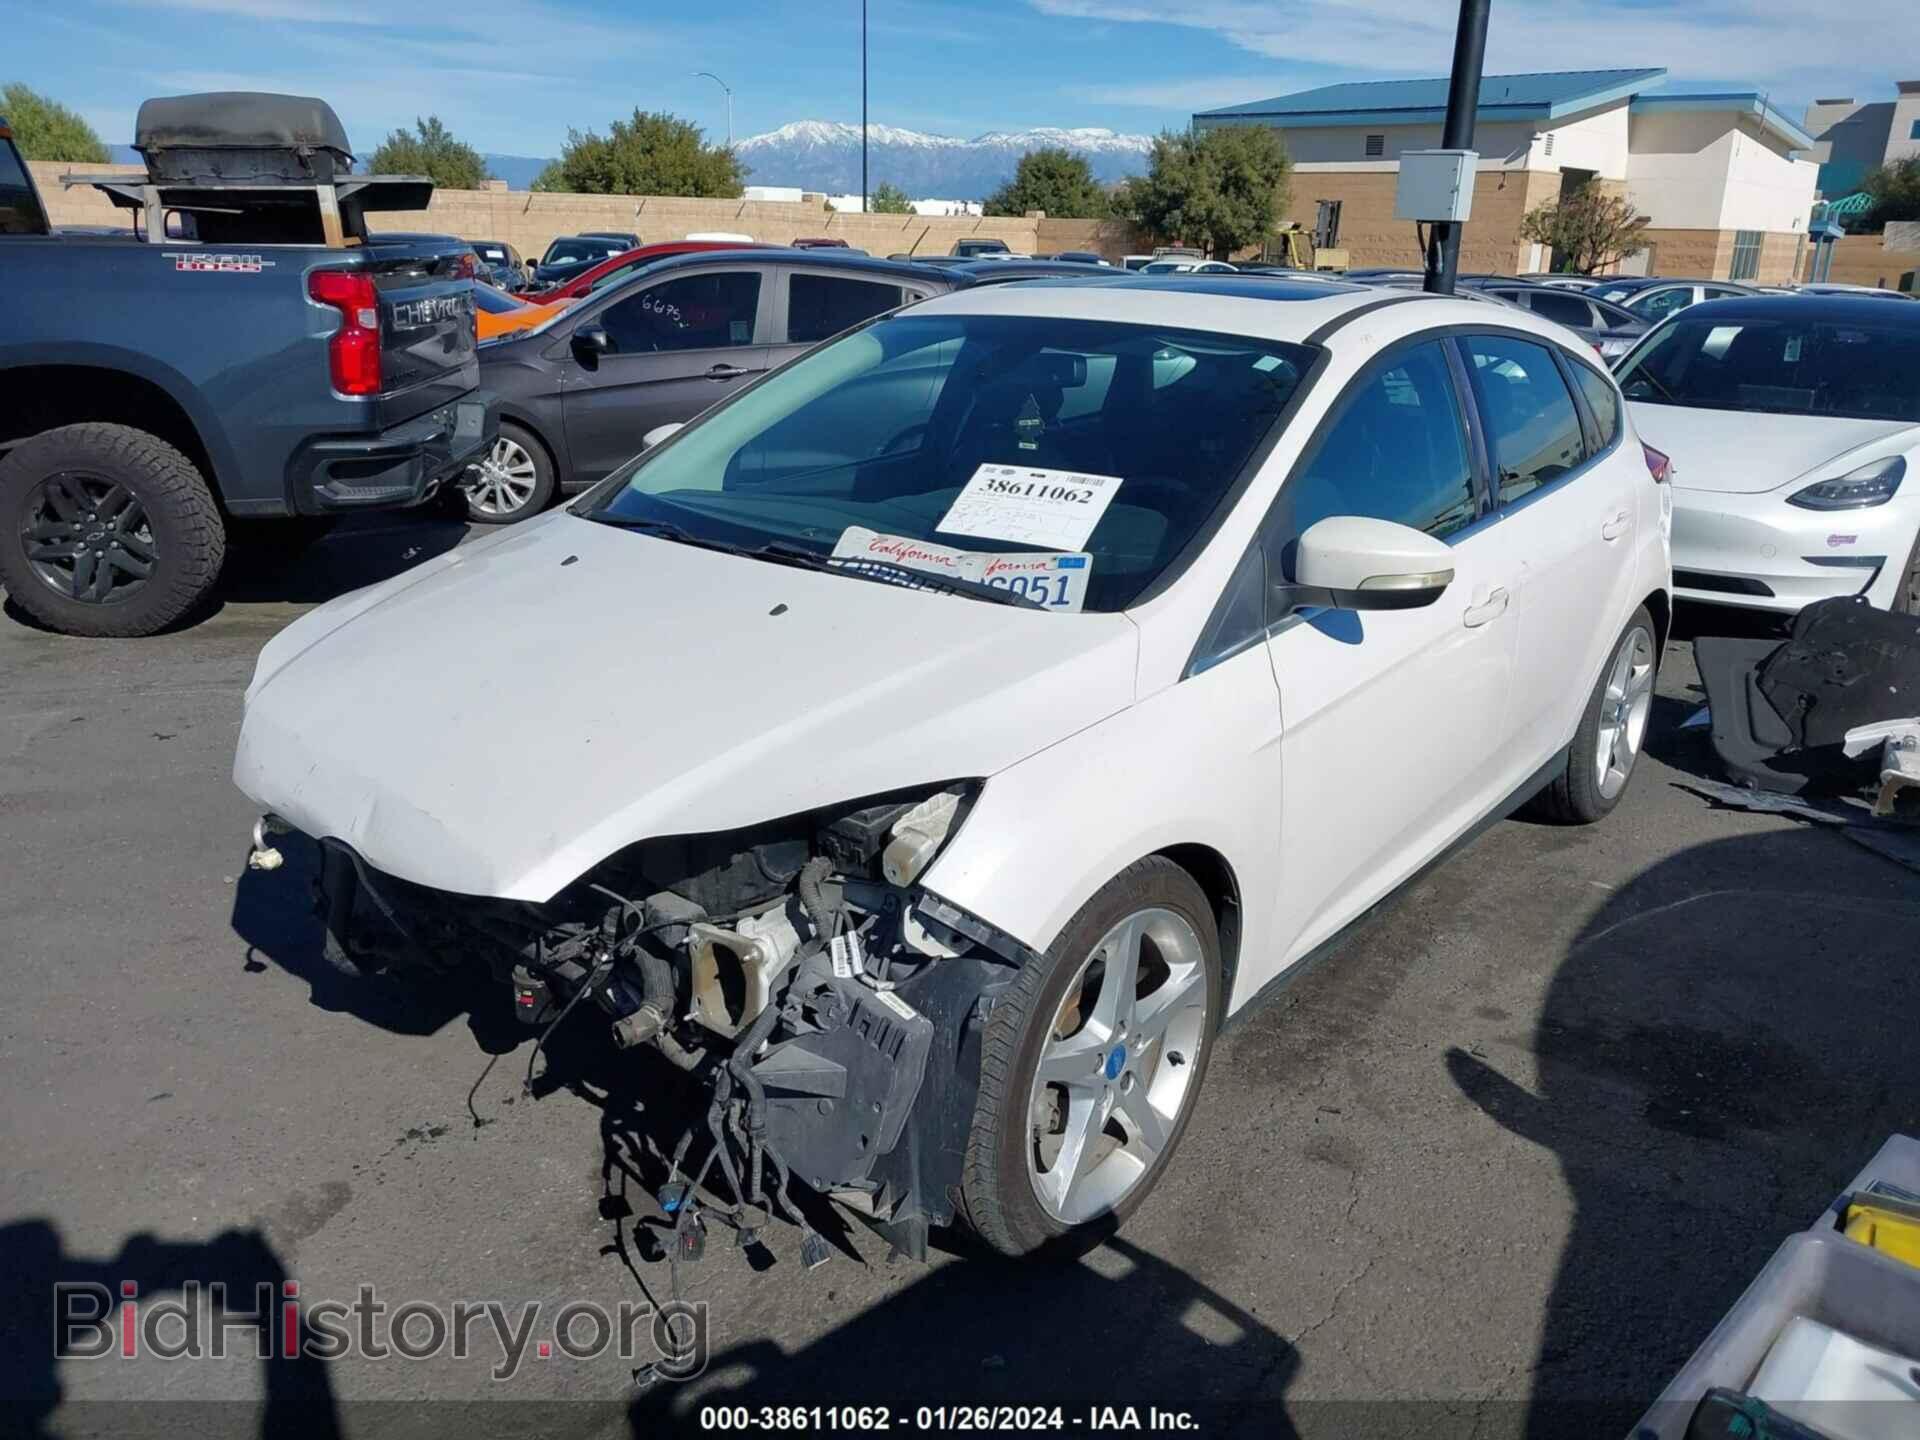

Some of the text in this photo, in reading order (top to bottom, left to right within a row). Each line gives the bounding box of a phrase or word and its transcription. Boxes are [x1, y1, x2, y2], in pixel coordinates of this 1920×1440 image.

[176, 261, 262, 273] BOSS
[978, 477, 1095, 505] 38611062
[867, 537, 957, 569] California
